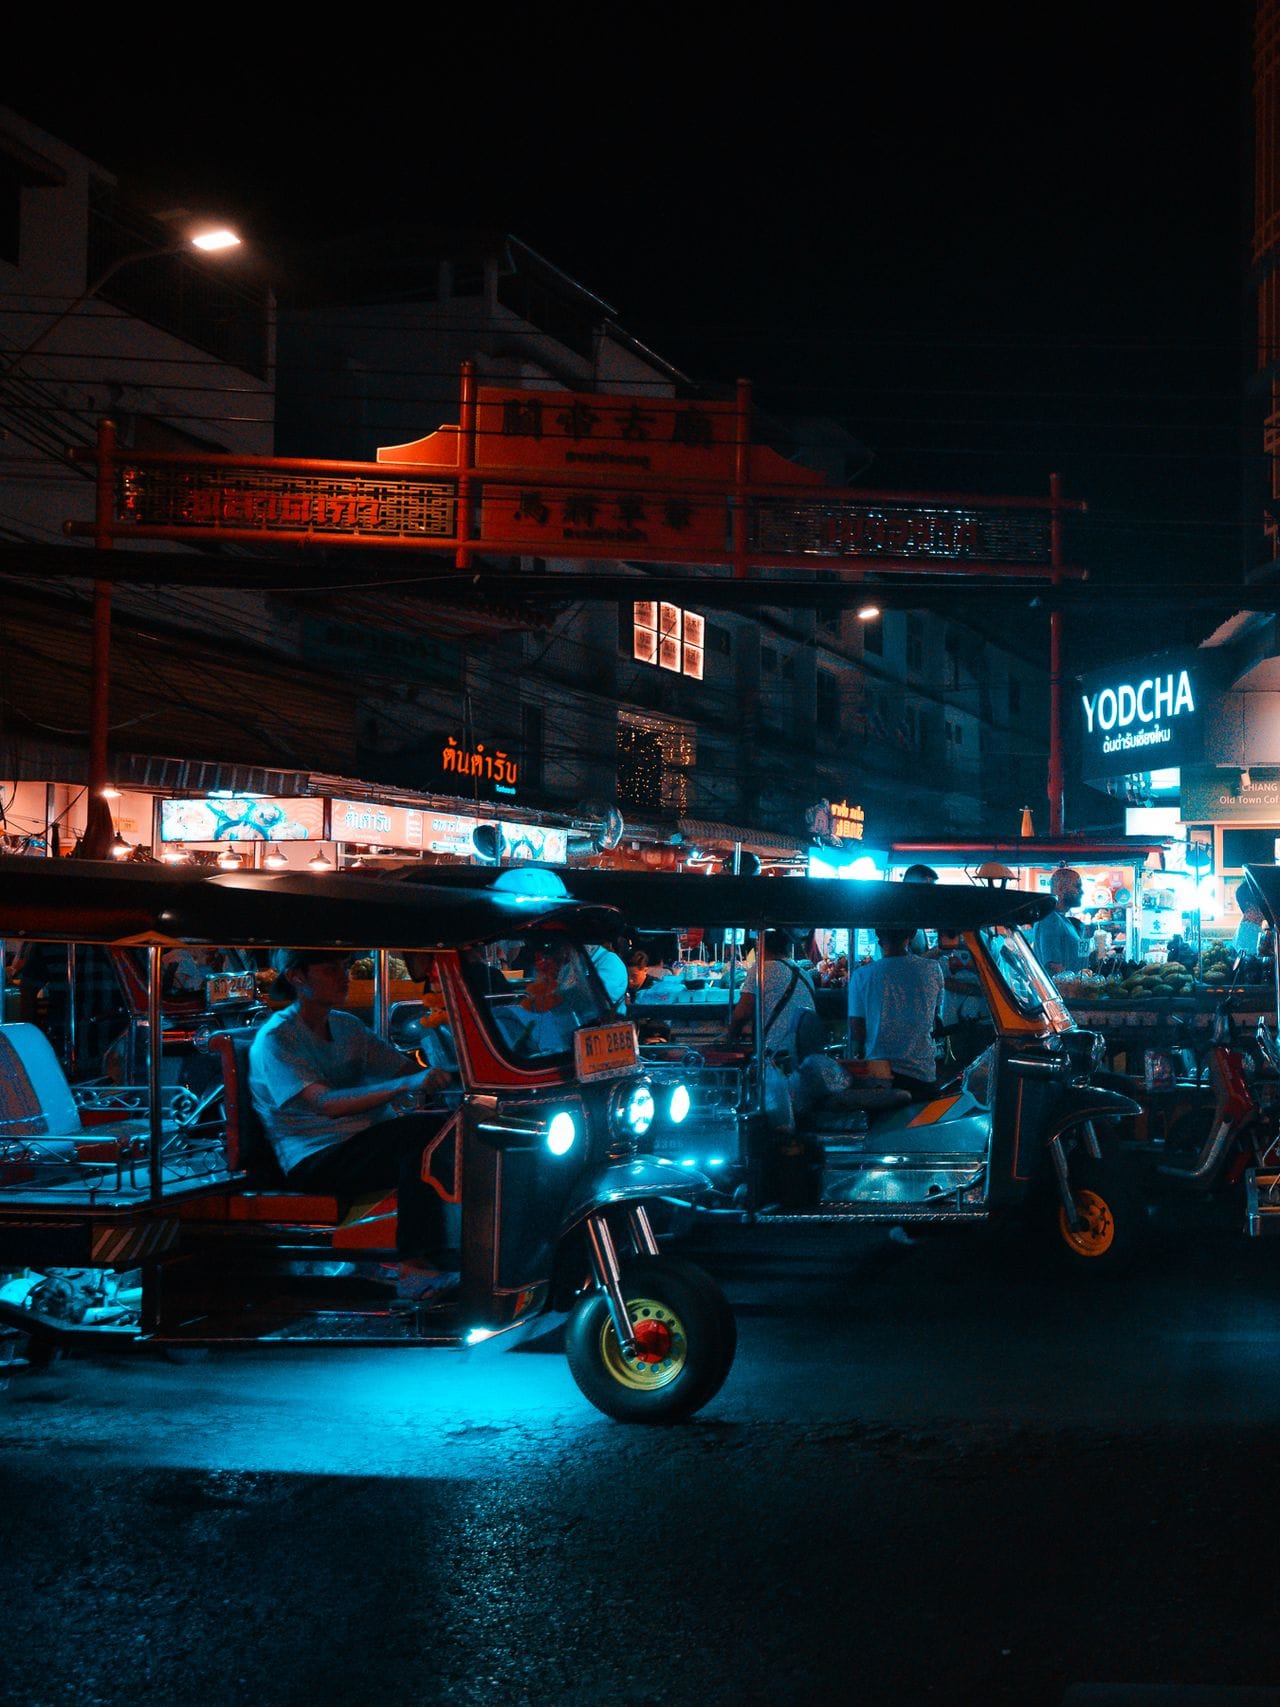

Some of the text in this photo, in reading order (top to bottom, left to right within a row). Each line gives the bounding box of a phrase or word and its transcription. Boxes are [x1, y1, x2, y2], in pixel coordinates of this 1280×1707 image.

[1082, 670, 1195, 733] YODCHA
[441, 735, 519, 785] ต้นตำรับ
[1219, 795, 1235, 804] Old
[1238, 795, 1261, 804] Town
[1242, 783, 1278, 792] CHIANG
[345, 804, 392, 833] ต้นตำรับ
